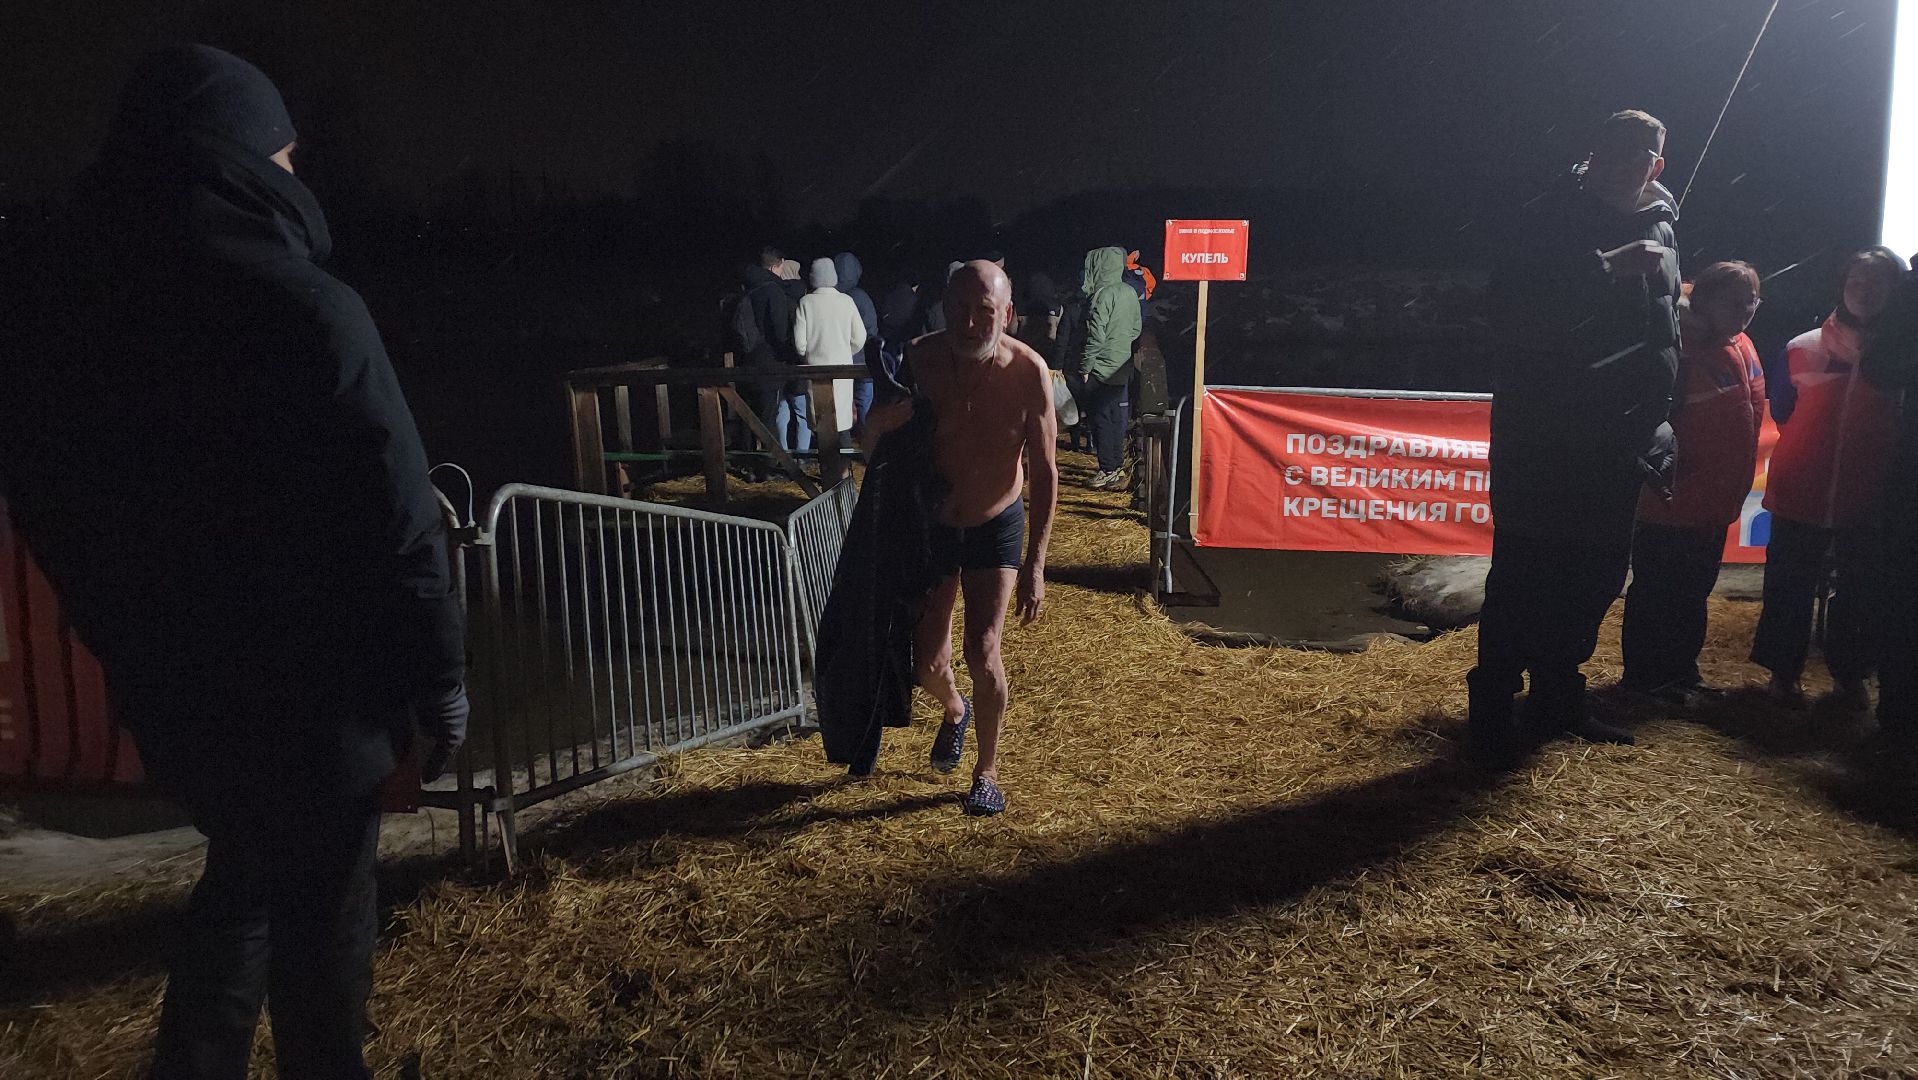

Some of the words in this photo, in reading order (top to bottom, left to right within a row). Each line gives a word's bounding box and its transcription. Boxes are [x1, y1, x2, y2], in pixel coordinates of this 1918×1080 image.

[1181, 252, 1229, 264] КУПЕЛЬ
[1286, 433, 1490, 459] ПОЗДРАВЛЯЕ
[1285, 466, 1304, 485] С
[1311, 467, 1455, 491] ВЕЛИКИМ
[1284, 496, 1448, 522] КРЕЩЕНИЯ
